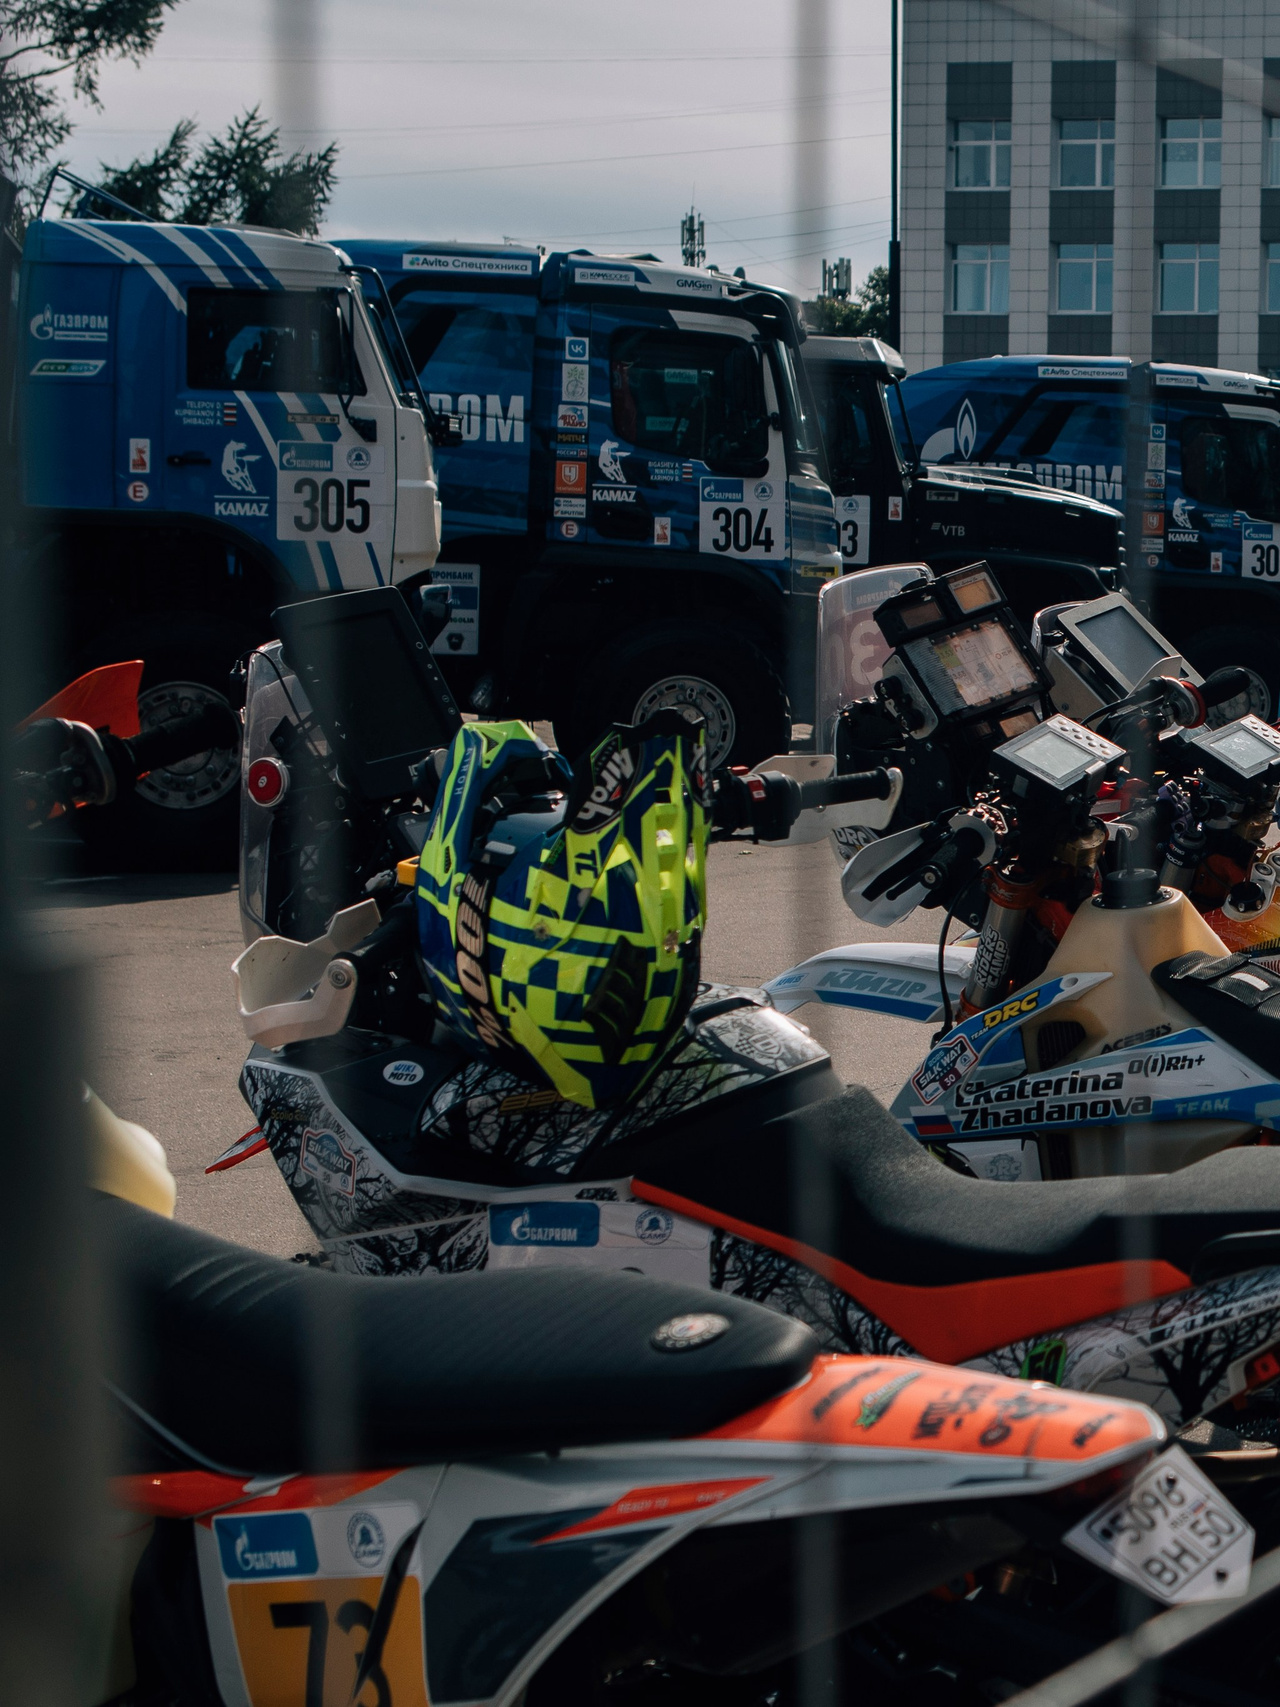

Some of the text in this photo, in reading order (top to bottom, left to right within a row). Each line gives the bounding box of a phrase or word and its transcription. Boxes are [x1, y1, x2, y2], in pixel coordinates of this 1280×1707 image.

[421, 257, 528, 271] Avito Спецтехника
[54, 314, 108, 329] ГАЗПРОМ
[571, 344, 583, 353] VK
[1050, 367, 1124, 378] Avito Спецтехника
[592, 489, 636, 503] KAMAZ
[214, 502, 269, 517] KAMAZ
[293, 477, 371, 534] 305
[712, 506, 774, 553] 304
[942, 525, 966, 537] VTB
[1168, 532, 1199, 543] KAMAZ
[977, 928, 1000, 989] RIDERS
[986, 939, 1008, 988] CAMP
[983, 990, 1040, 1029] DRC
[970, 1026, 990, 1041] TEAM
[393, 1062, 416, 1073] WIKI
[919, 1042, 963, 1088] SILK WAY
[387, 1072, 417, 1082] MOTO
[943, 1073, 956, 1087] 30
[960, 1095, 1152, 1133] Zhadanova
[1174, 1097, 1230, 1117] TEAM
[307, 1140, 352, 1172] SILK WAY
[529, 1226, 578, 1242] GAZPROM
[252, 1549, 298, 1570] GAZPROM
